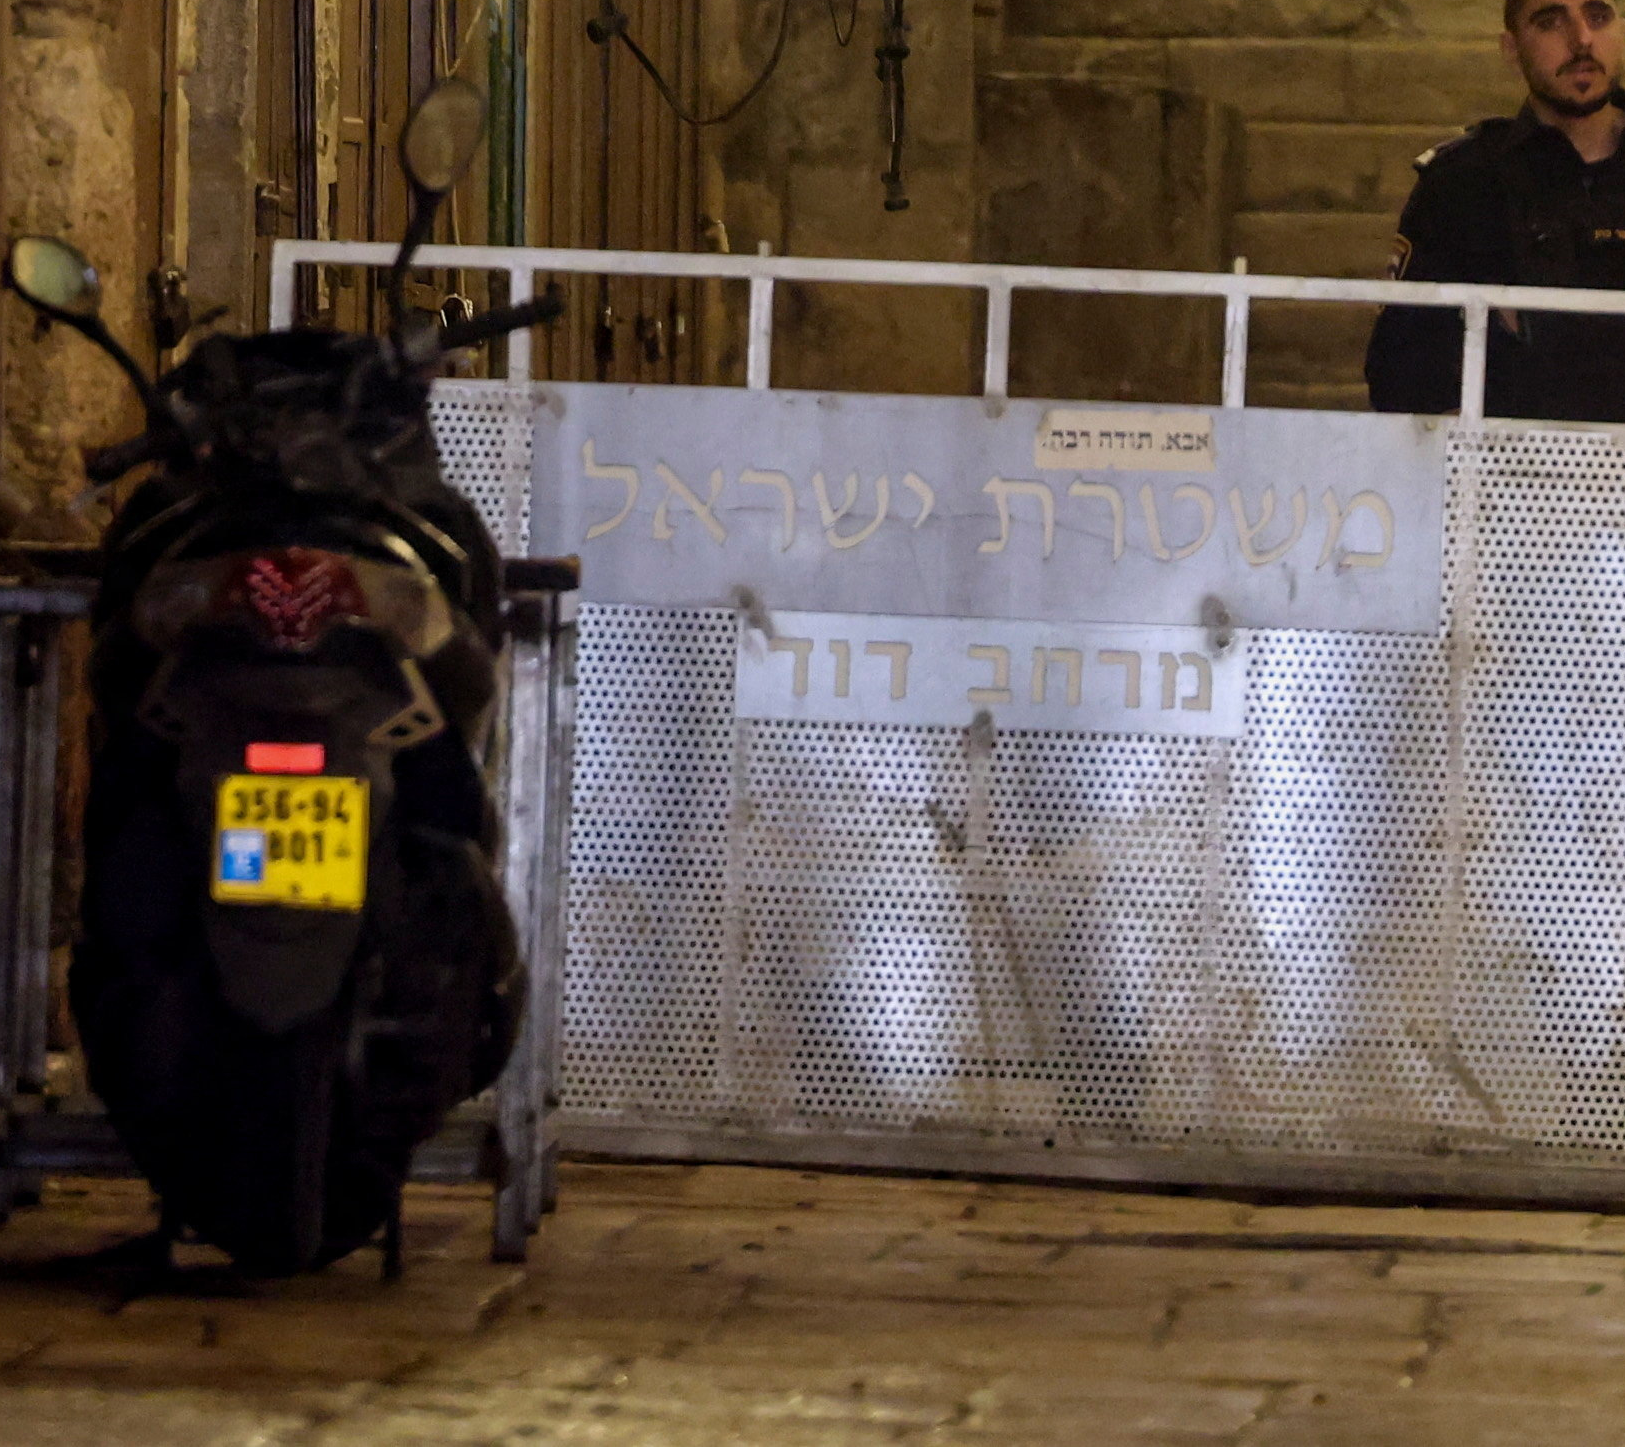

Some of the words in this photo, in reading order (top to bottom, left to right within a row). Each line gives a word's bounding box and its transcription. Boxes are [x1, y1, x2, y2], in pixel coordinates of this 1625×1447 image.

[1099, 429, 1153, 450] תודה
[581, 438, 935, 552] ישראל
[977, 476, 1395, 571] משטרת
[768, 637, 914, 700] דוד
[967, 642, 1213, 713] מרחב
